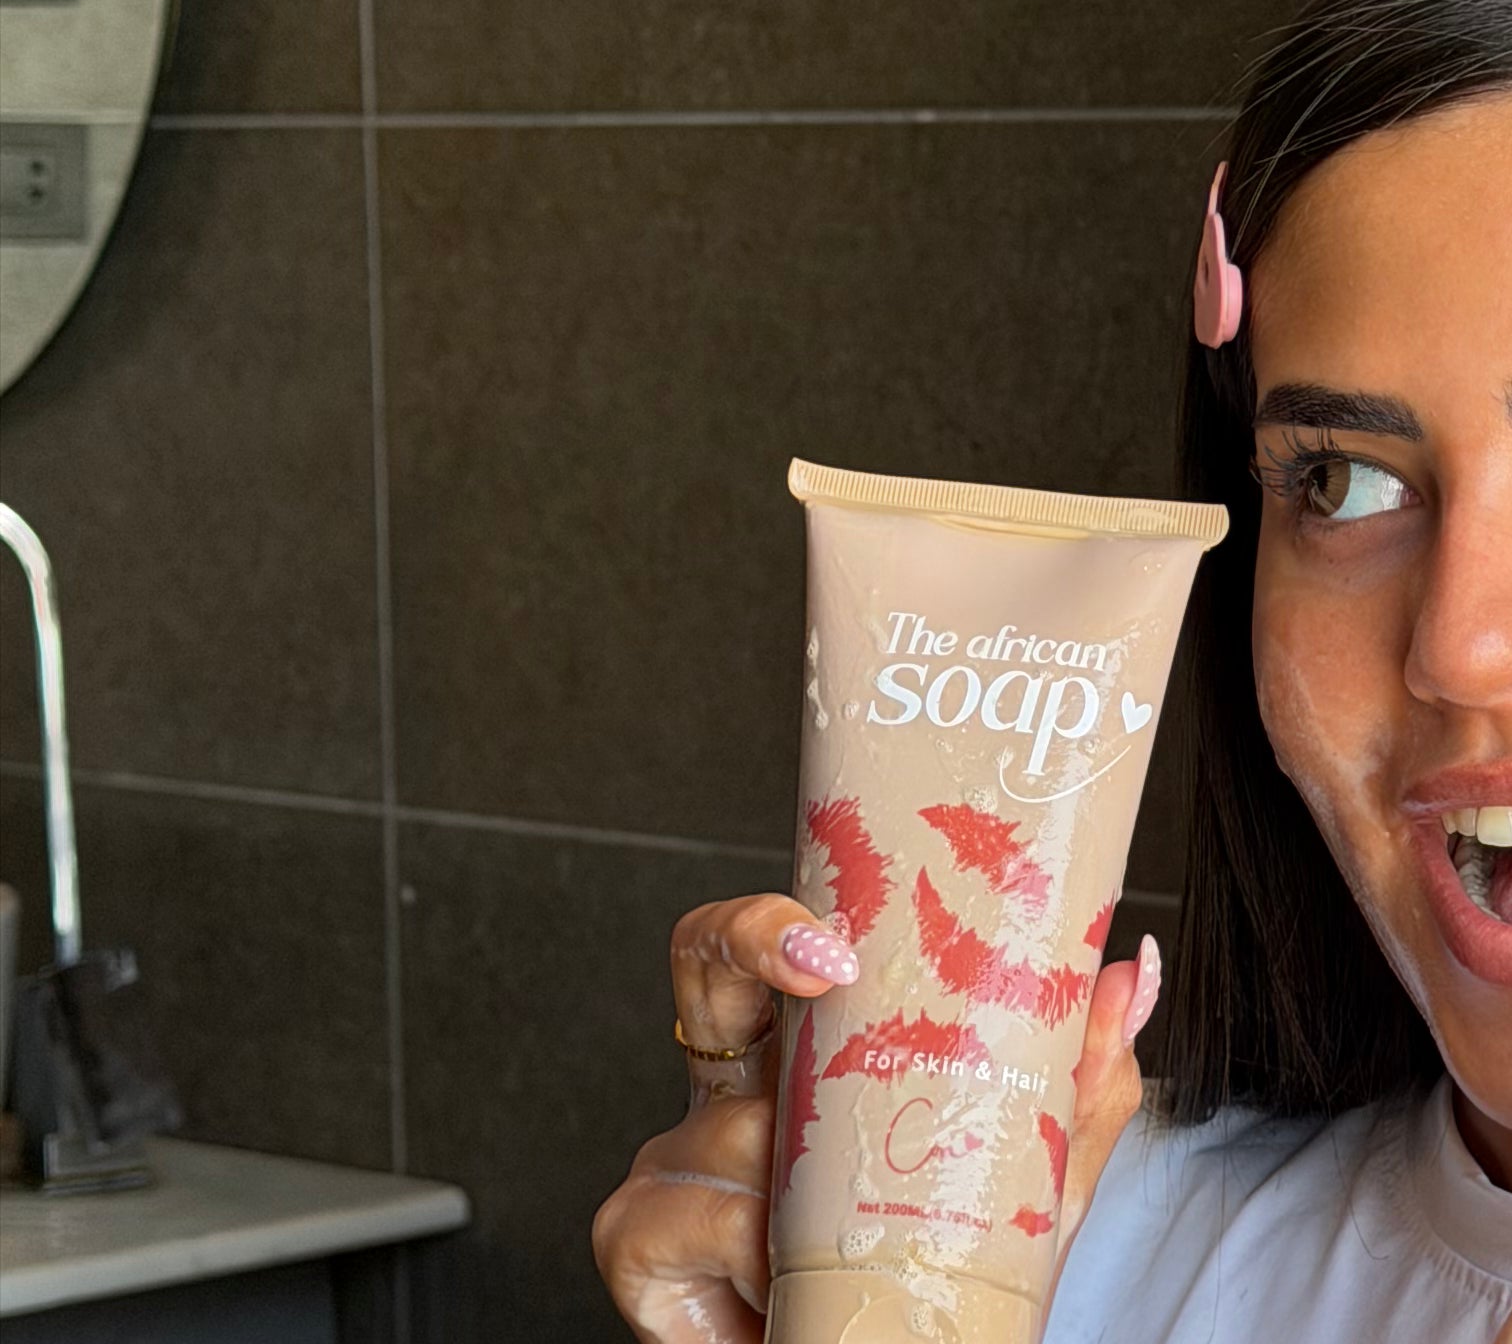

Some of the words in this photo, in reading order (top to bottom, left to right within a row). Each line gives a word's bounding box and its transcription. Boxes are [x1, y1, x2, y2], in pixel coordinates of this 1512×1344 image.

[887, 611, 958, 656] The
[966, 624, 1107, 672] african
[866, 662, 1100, 777] soap
[864, 1050, 902, 1071] For
[911, 1052, 965, 1077] Skin
[975, 1060, 992, 1081] &
[1002, 1065, 1048, 1093] Hair
[857, 1201, 880, 1214] Net
